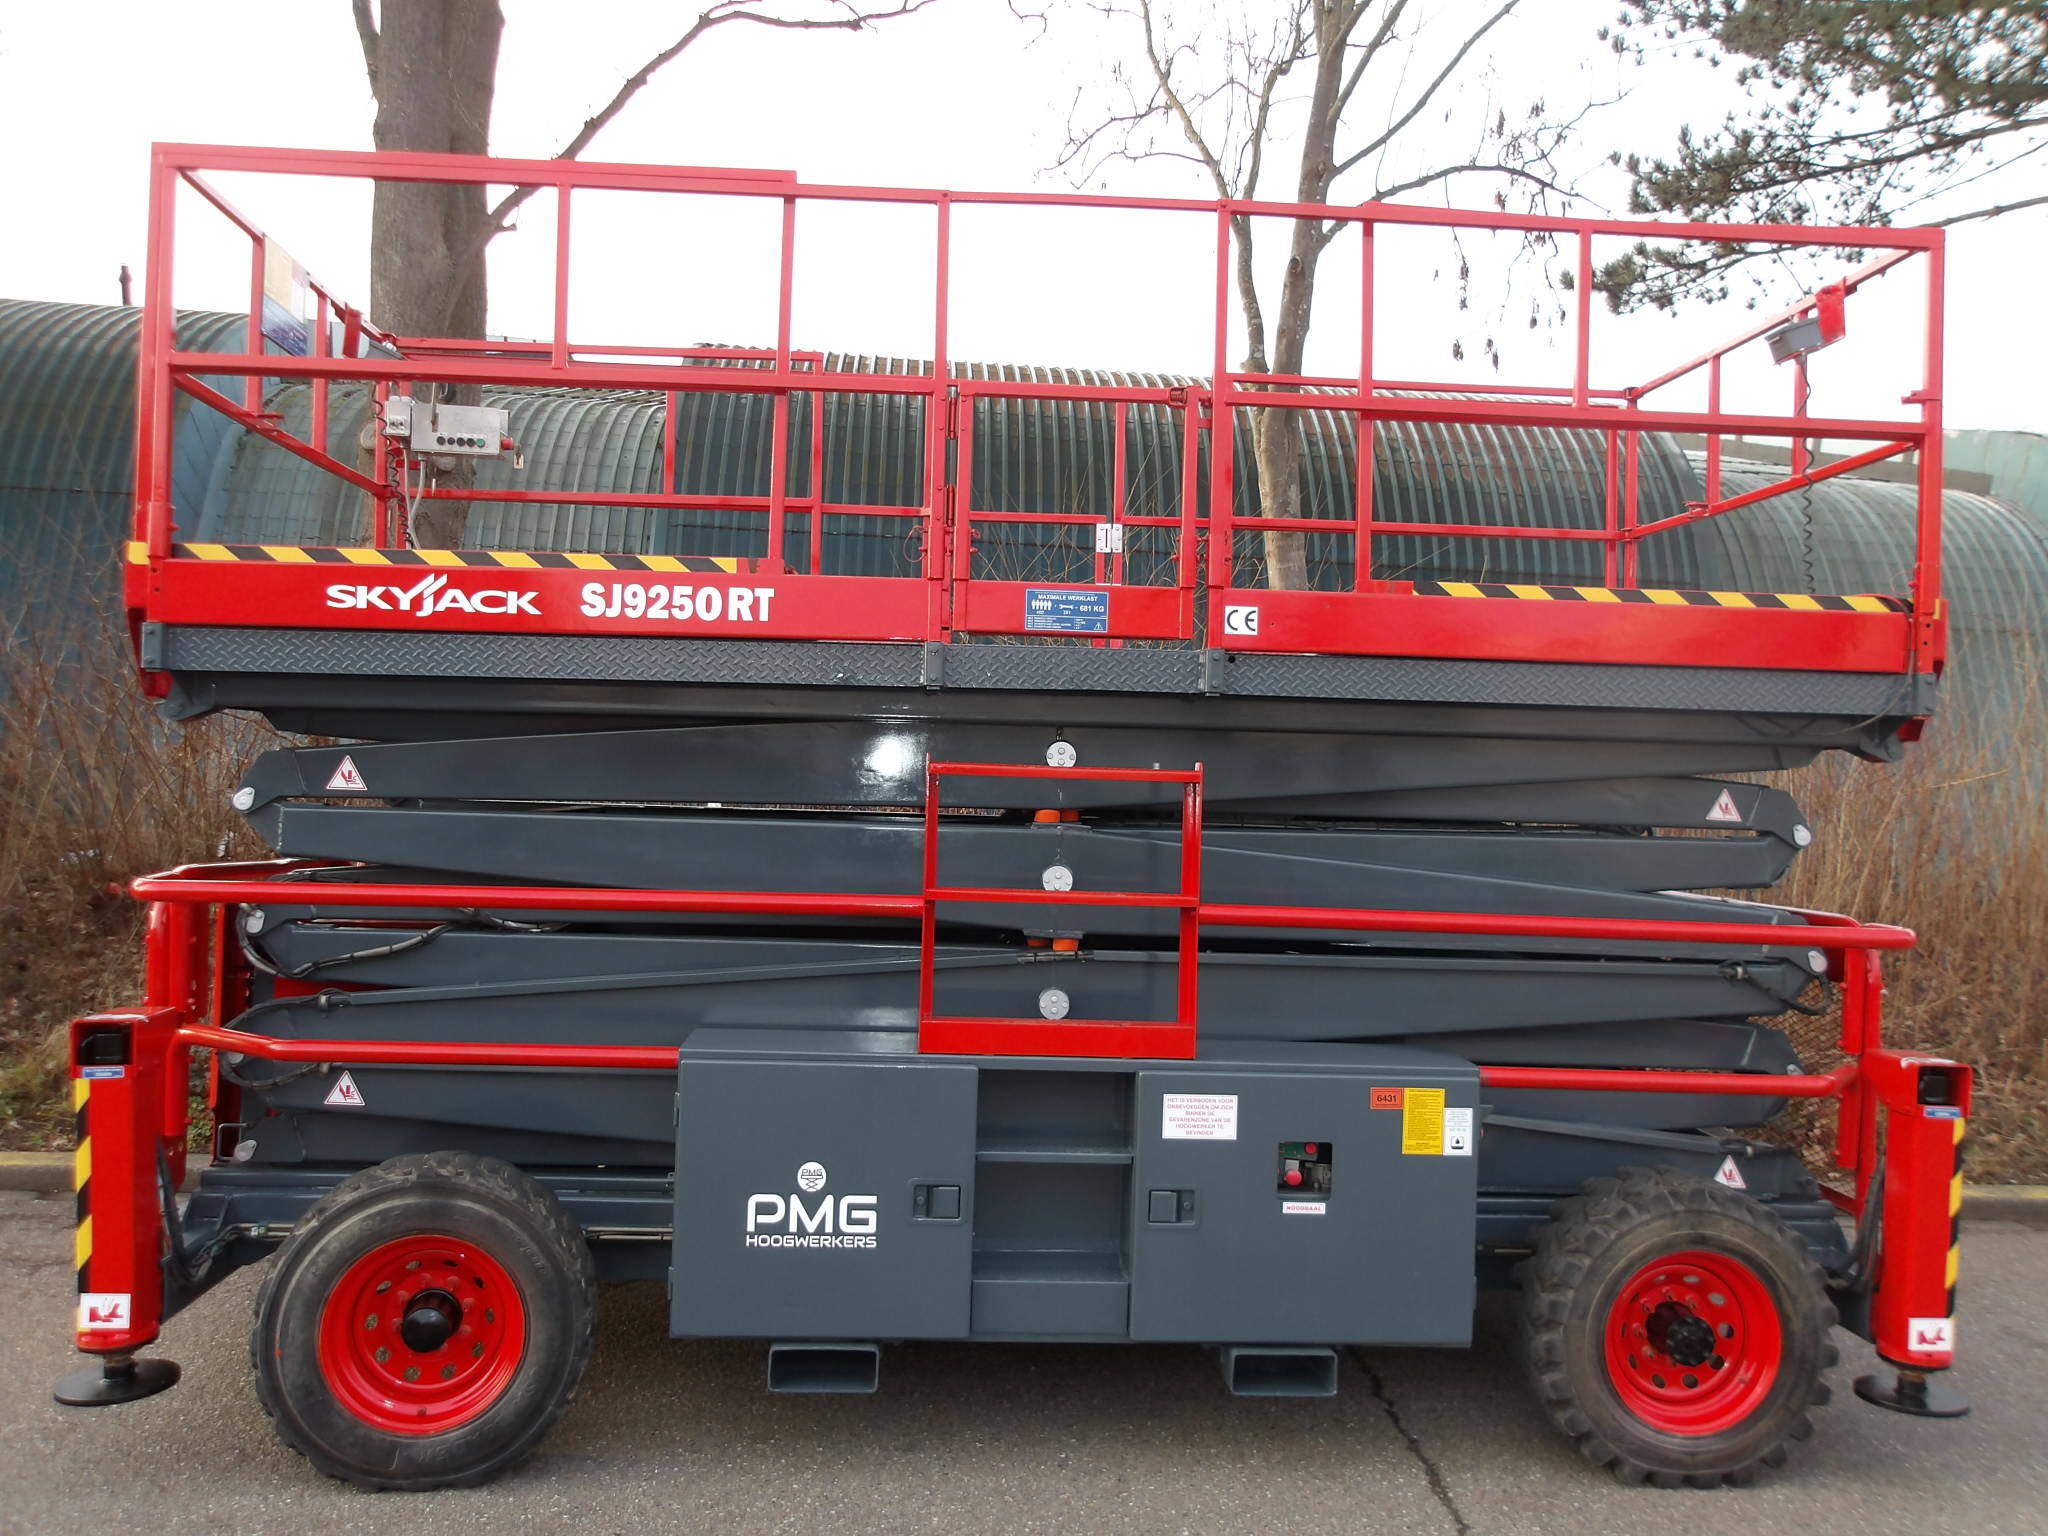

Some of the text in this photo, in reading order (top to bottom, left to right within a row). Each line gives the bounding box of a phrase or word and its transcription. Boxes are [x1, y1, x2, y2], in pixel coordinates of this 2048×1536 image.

[326, 573, 542, 617] SKYJACK
[1376, 1094, 1397, 1103] 6431
[802, 1168, 823, 1176] PMG
[746, 1193, 877, 1233] PMG
[746, 1235, 877, 1248] HOOGWERKERS
